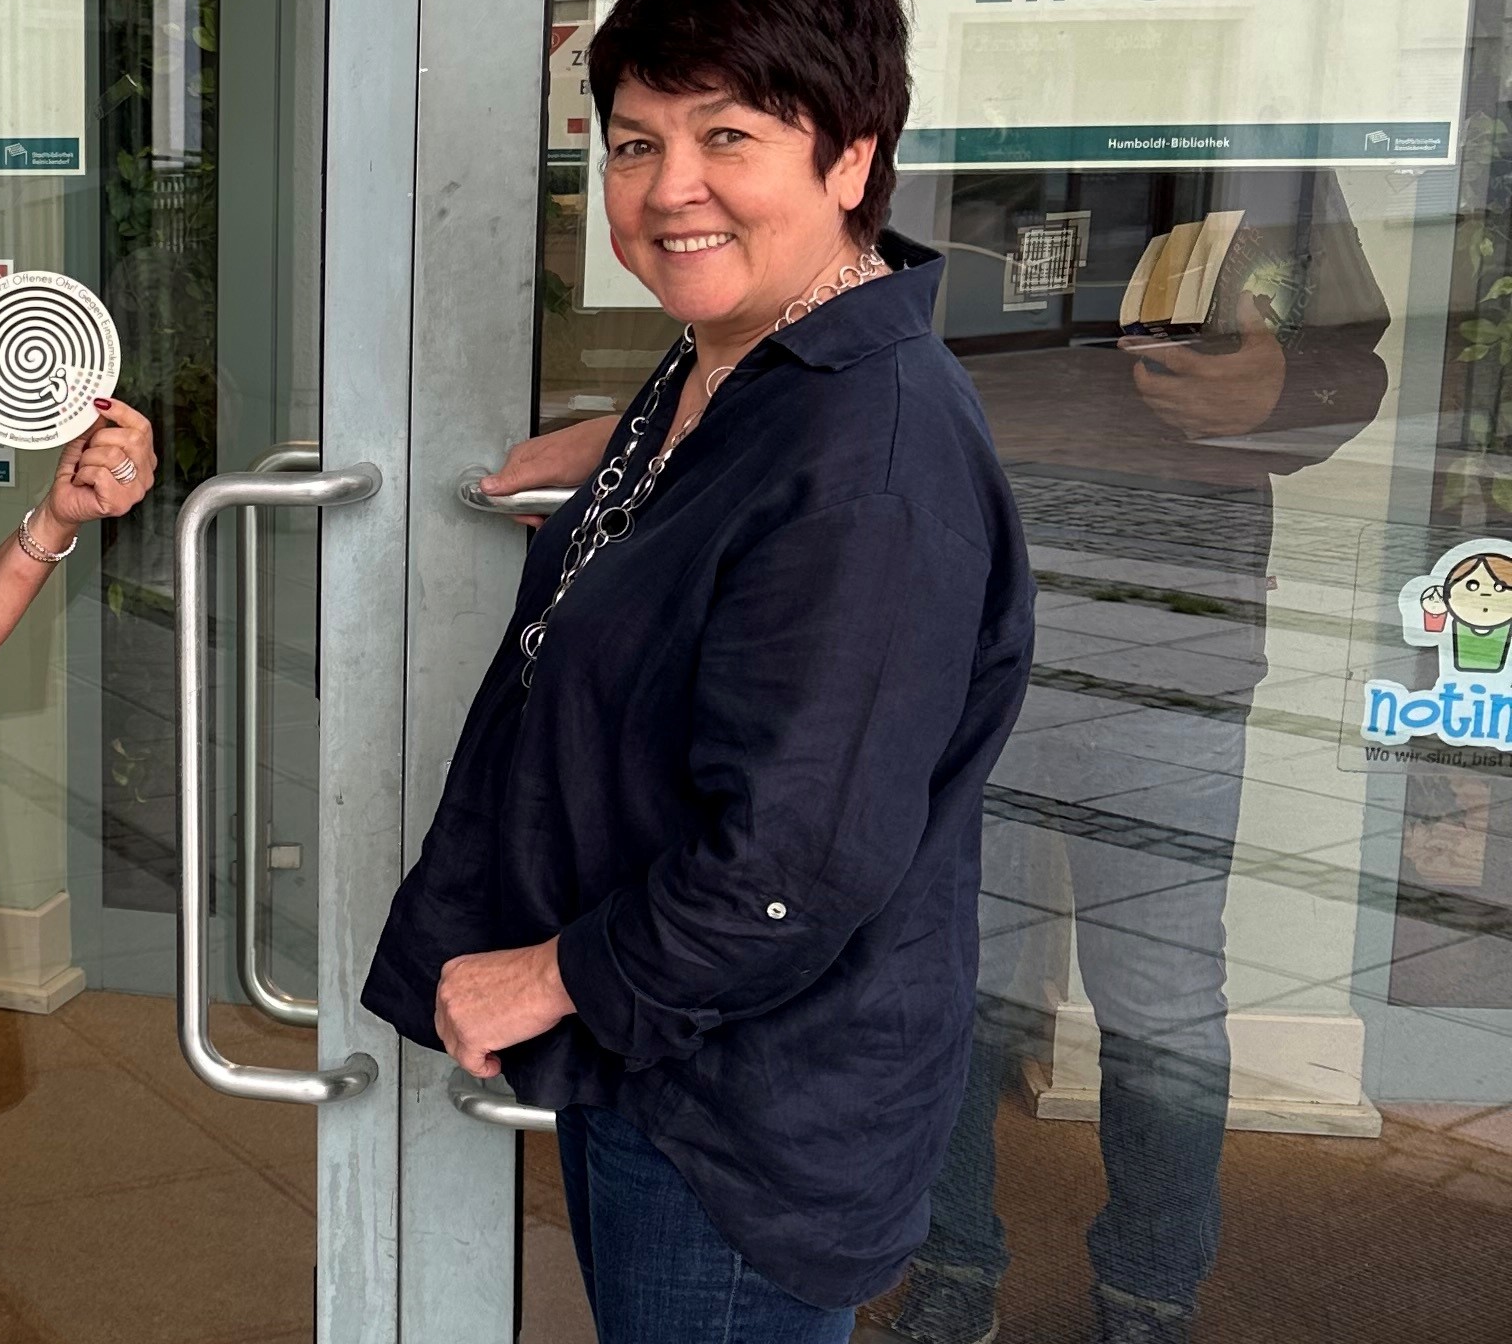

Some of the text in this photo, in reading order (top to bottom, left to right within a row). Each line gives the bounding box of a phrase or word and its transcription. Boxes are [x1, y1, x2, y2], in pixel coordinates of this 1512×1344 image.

[1108, 136, 1230, 149] Humboldt-Bibliothek
[12, 273, 53, 286] Offenes
[55, 276, 79, 293] Ohr!
[78, 289, 104, 320] Gegen
[1365, 746, 1390, 762] Wo
[1394, 748, 1421, 763] wir
[1424, 750, 1467, 768] sind,
[1472, 751, 1502, 767] bist
